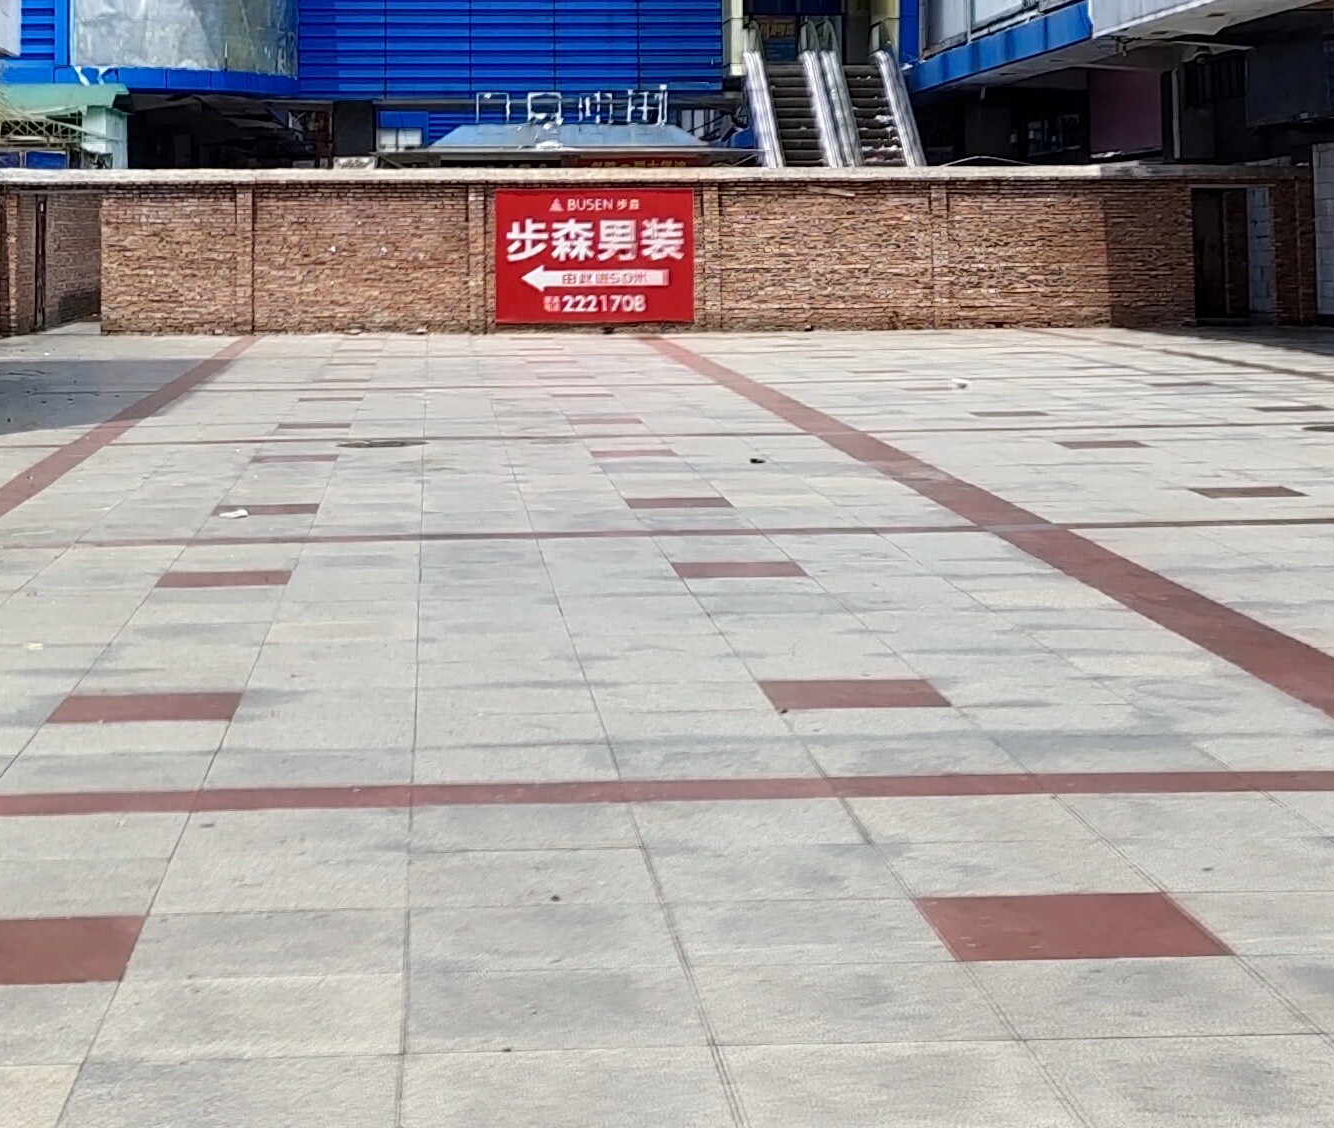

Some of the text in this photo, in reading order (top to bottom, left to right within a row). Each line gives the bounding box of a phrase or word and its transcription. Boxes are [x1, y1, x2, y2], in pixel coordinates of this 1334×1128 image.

[567, 198, 614, 211] BUSEN
[505, 217, 685, 262] 步森男装
[561, 294, 646, 313] 2221708
